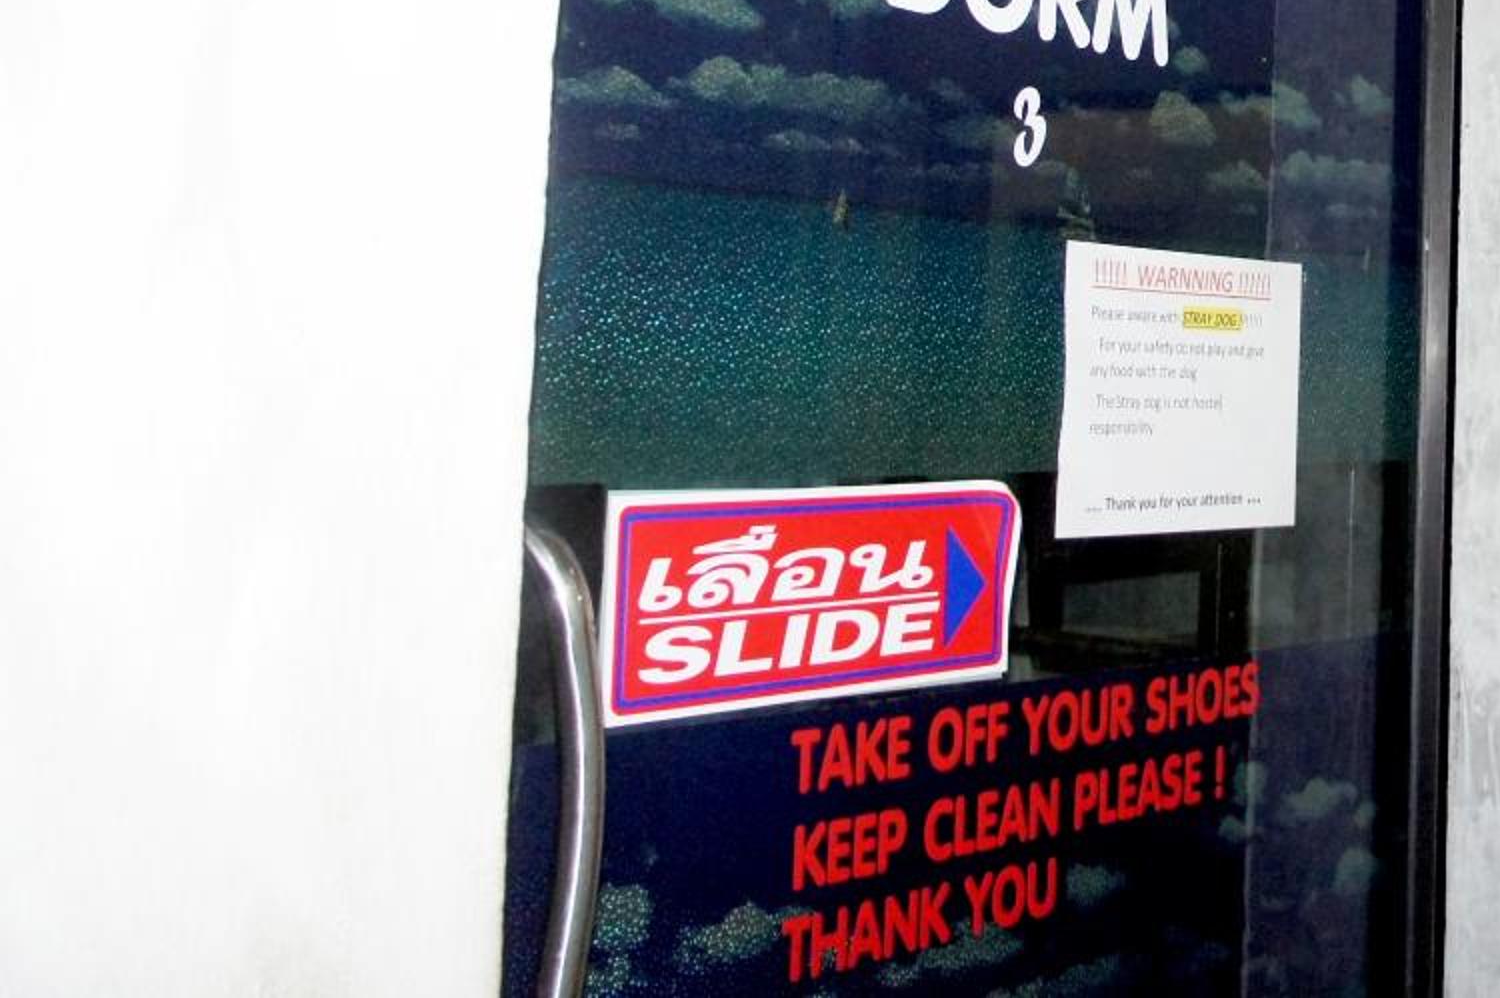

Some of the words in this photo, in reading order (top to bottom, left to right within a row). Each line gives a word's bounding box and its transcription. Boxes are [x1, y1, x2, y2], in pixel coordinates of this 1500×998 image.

[1013, 86, 1047, 167] 3
[1137, 264, 1235, 293] WARNNING
[1090, 305, 1125, 320] Please
[1183, 308, 1213, 326] STRAY
[1215, 311, 1238, 328] DOG
[1089, 366, 1108, 380] any
[1109, 363, 1135, 377] food
[1179, 365, 1199, 382] dog
[1099, 338, 1116, 351] For
[1118, 341, 1143, 355] your
[1144, 340, 1174, 356] safety
[1207, 344, 1227, 359] play
[1096, 393, 1116, 408] The
[1173, 397, 1190, 409] not
[1105, 496, 1137, 512] Thank
[1138, 499, 1156, 513] you
[1158, 494, 1174, 509] for
[1175, 496, 1198, 513] your
[1199, 493, 1243, 508] attention
[637, 525, 935, 612] เลื่อน
[638, 600, 941, 685] SLIDE
[791, 714, 912, 795] TAKE
[927, 701, 1010, 773] OFF
[1021, 683, 1135, 756] YOUR
[1146, 661, 1261, 735] SHOES
[792, 808, 908, 891] KEEP
[923, 777, 1060, 863] CLEAN
[1074, 751, 1204, 831] PLEASE
[1214, 745, 1226, 799] !
[781, 881, 952, 983] THANK
[964, 857, 1058, 938] YOU
